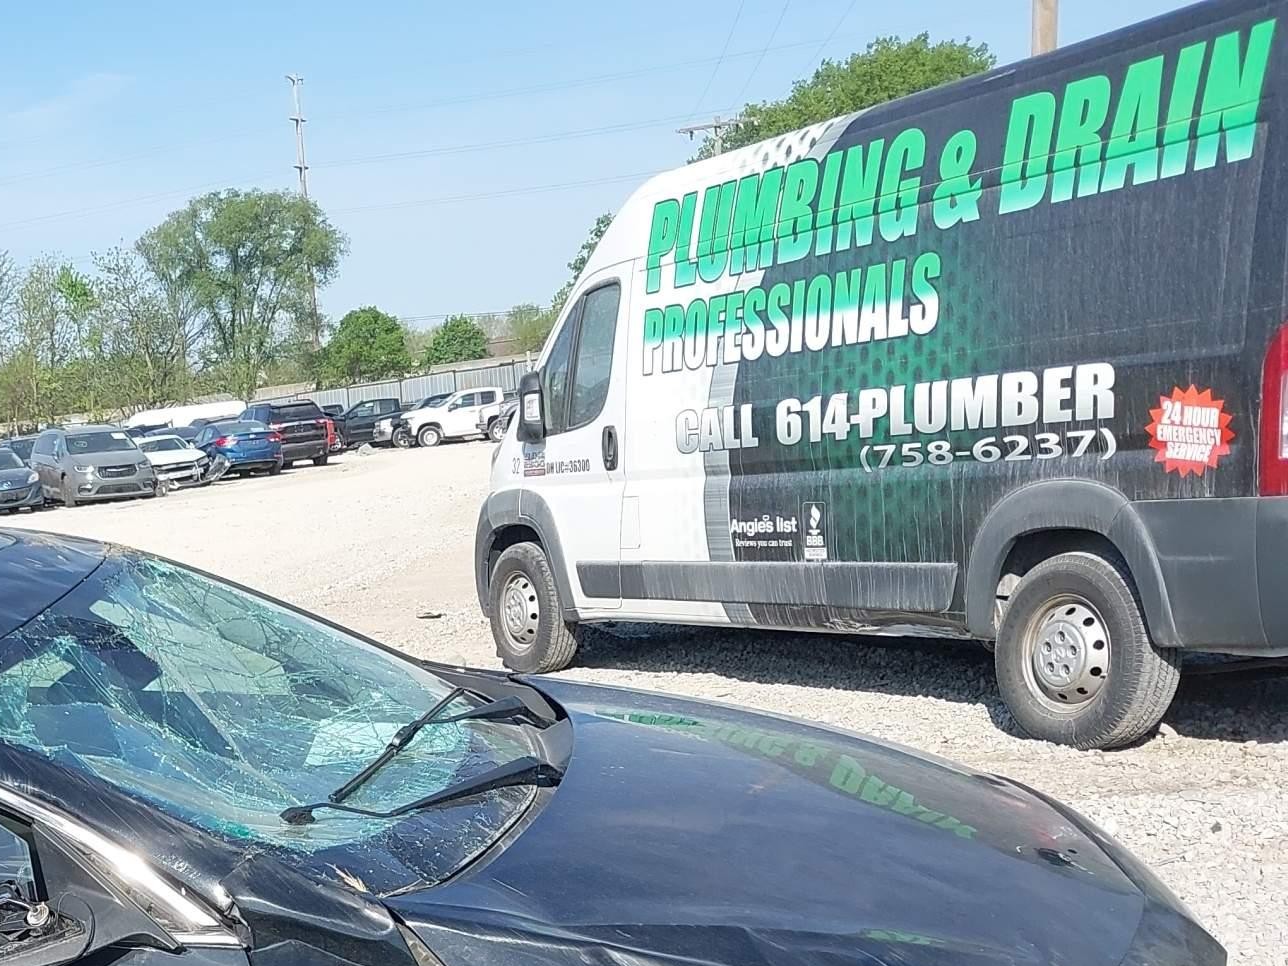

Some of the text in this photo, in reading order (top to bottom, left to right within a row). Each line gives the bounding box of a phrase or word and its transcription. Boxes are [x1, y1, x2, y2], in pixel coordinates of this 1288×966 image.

[646, 19, 1277, 294] PLUMBING & DRAIN
[642, 251, 942, 376] PROFESSIONALS
[1160, 400, 1220, 428] 24 HOUR
[675, 403, 760, 454] CALL
[1156, 424, 1222, 447] EMERGENCY
[859, 428, 1118, 473] (758-6237)
[1165, 441, 1214, 463] SERVICE
[512, 457, 521, 475] 32
[776, 516, 797, 533] list
[806, 535, 824, 547] BBB
